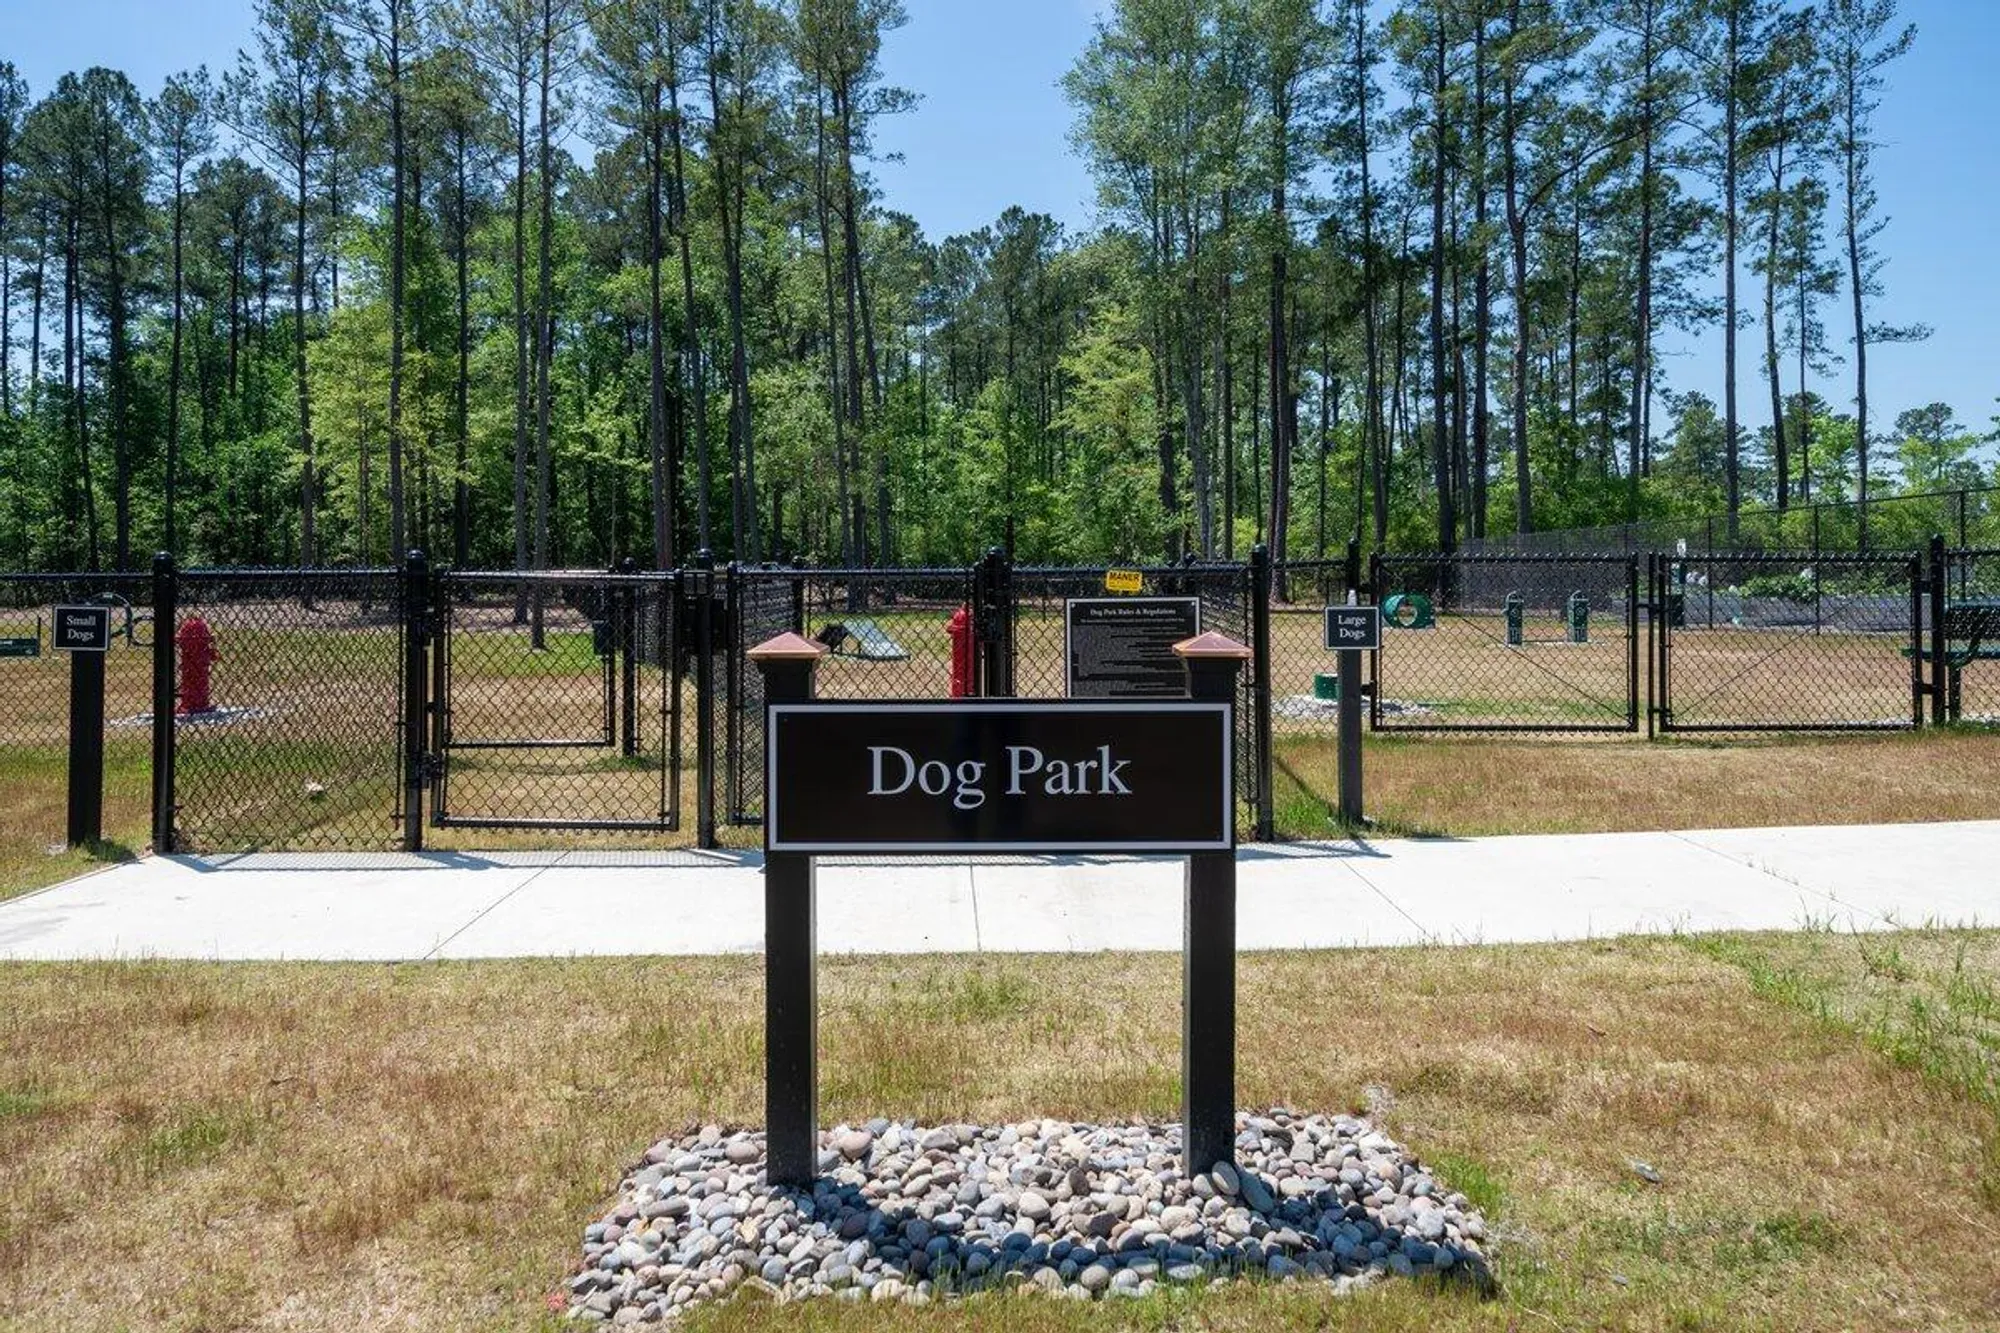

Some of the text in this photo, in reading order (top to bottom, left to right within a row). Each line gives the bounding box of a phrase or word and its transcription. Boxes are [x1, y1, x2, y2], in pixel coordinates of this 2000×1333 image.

[66, 615, 96, 626] Small
[1338, 615, 1366, 627] Large
[67, 628, 95, 642] Dogs
[1339, 628, 1366, 640] Dogs
[866, 744, 1133, 810] Dog Park
